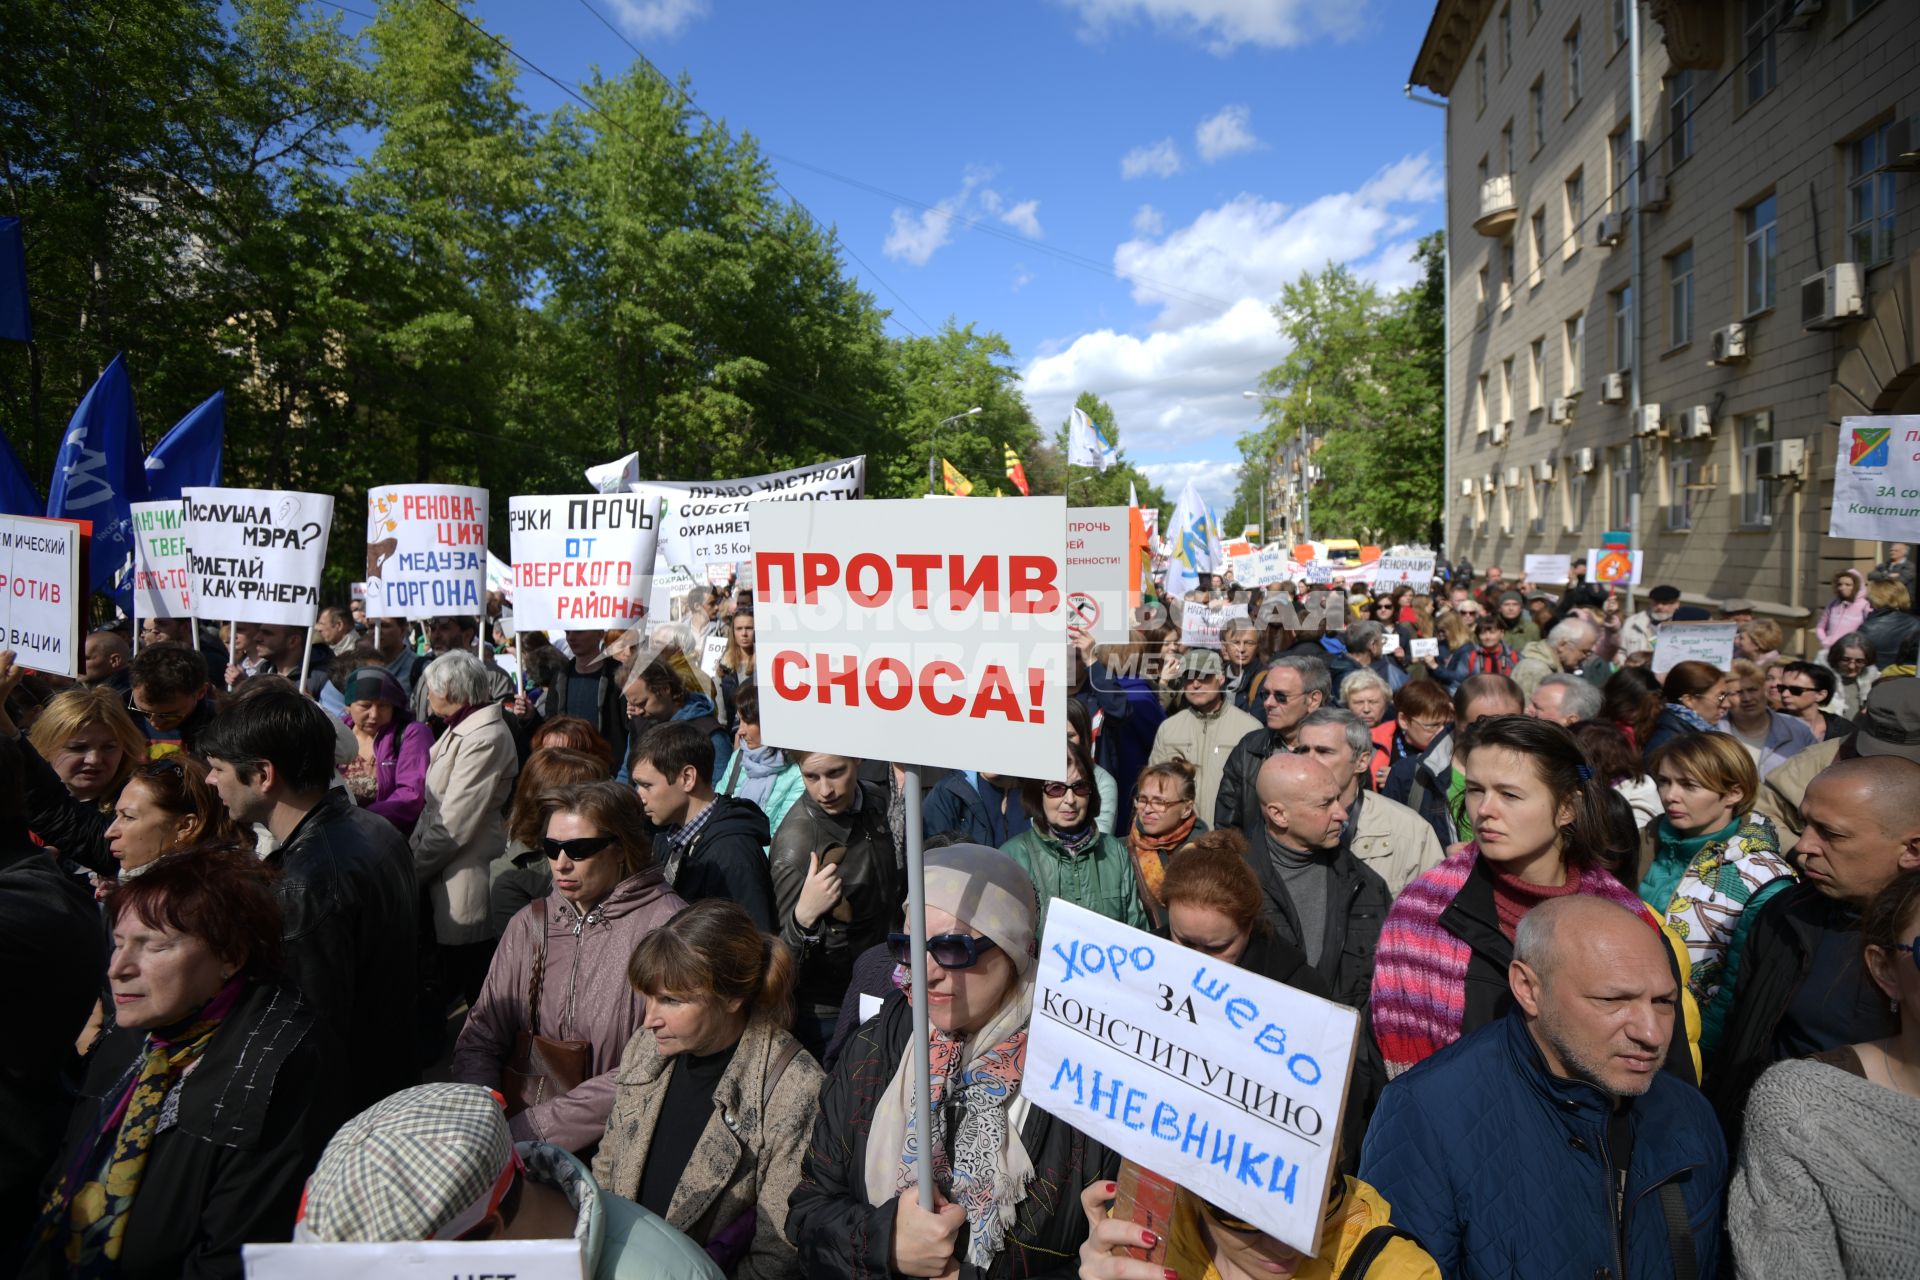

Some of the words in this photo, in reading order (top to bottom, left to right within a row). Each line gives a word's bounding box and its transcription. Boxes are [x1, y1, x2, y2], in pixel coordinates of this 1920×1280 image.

[689, 485, 753, 498] ПРАВО
[757, 461, 856, 492] ЧАСТНОЙ
[1876, 486, 1896, 497] ЗА
[183, 496, 272, 524] ПОСЛУШАЛ
[403, 494, 481, 522] РЕНОВА-
[510, 508, 551, 532] РУКИ
[568, 499, 653, 530] ПРОЧЬ
[243, 523, 322, 550] МЭРА?
[437, 522, 484, 546] ЦИЯ
[1068, 522, 1111, 532] ПРОЧЬ
[565, 537, 597, 559] ОТ
[696, 546, 711, 556] ст.
[714, 543, 728, 555] 35
[186, 547, 264, 578] ПРОЛЕТАЙ
[512, 560, 632, 588] ТВЕРСКОГО
[1378, 559, 1432, 571] РЕНОВАЦИЯ
[203, 578, 236, 598] КАК
[386, 579, 479, 608] ГОРГОНА
[756, 552, 1061, 614] ПРОТИВ
[557, 590, 646, 620] РАЙОНА
[771, 650, 1045, 724] СНОСА!
[1155, 982, 1199, 1025] ЗА
[1041, 987, 1322, 1137] КОНСТИТУЦИЮ
[1049, 1057, 1300, 1204] МНЕВНИКИ
